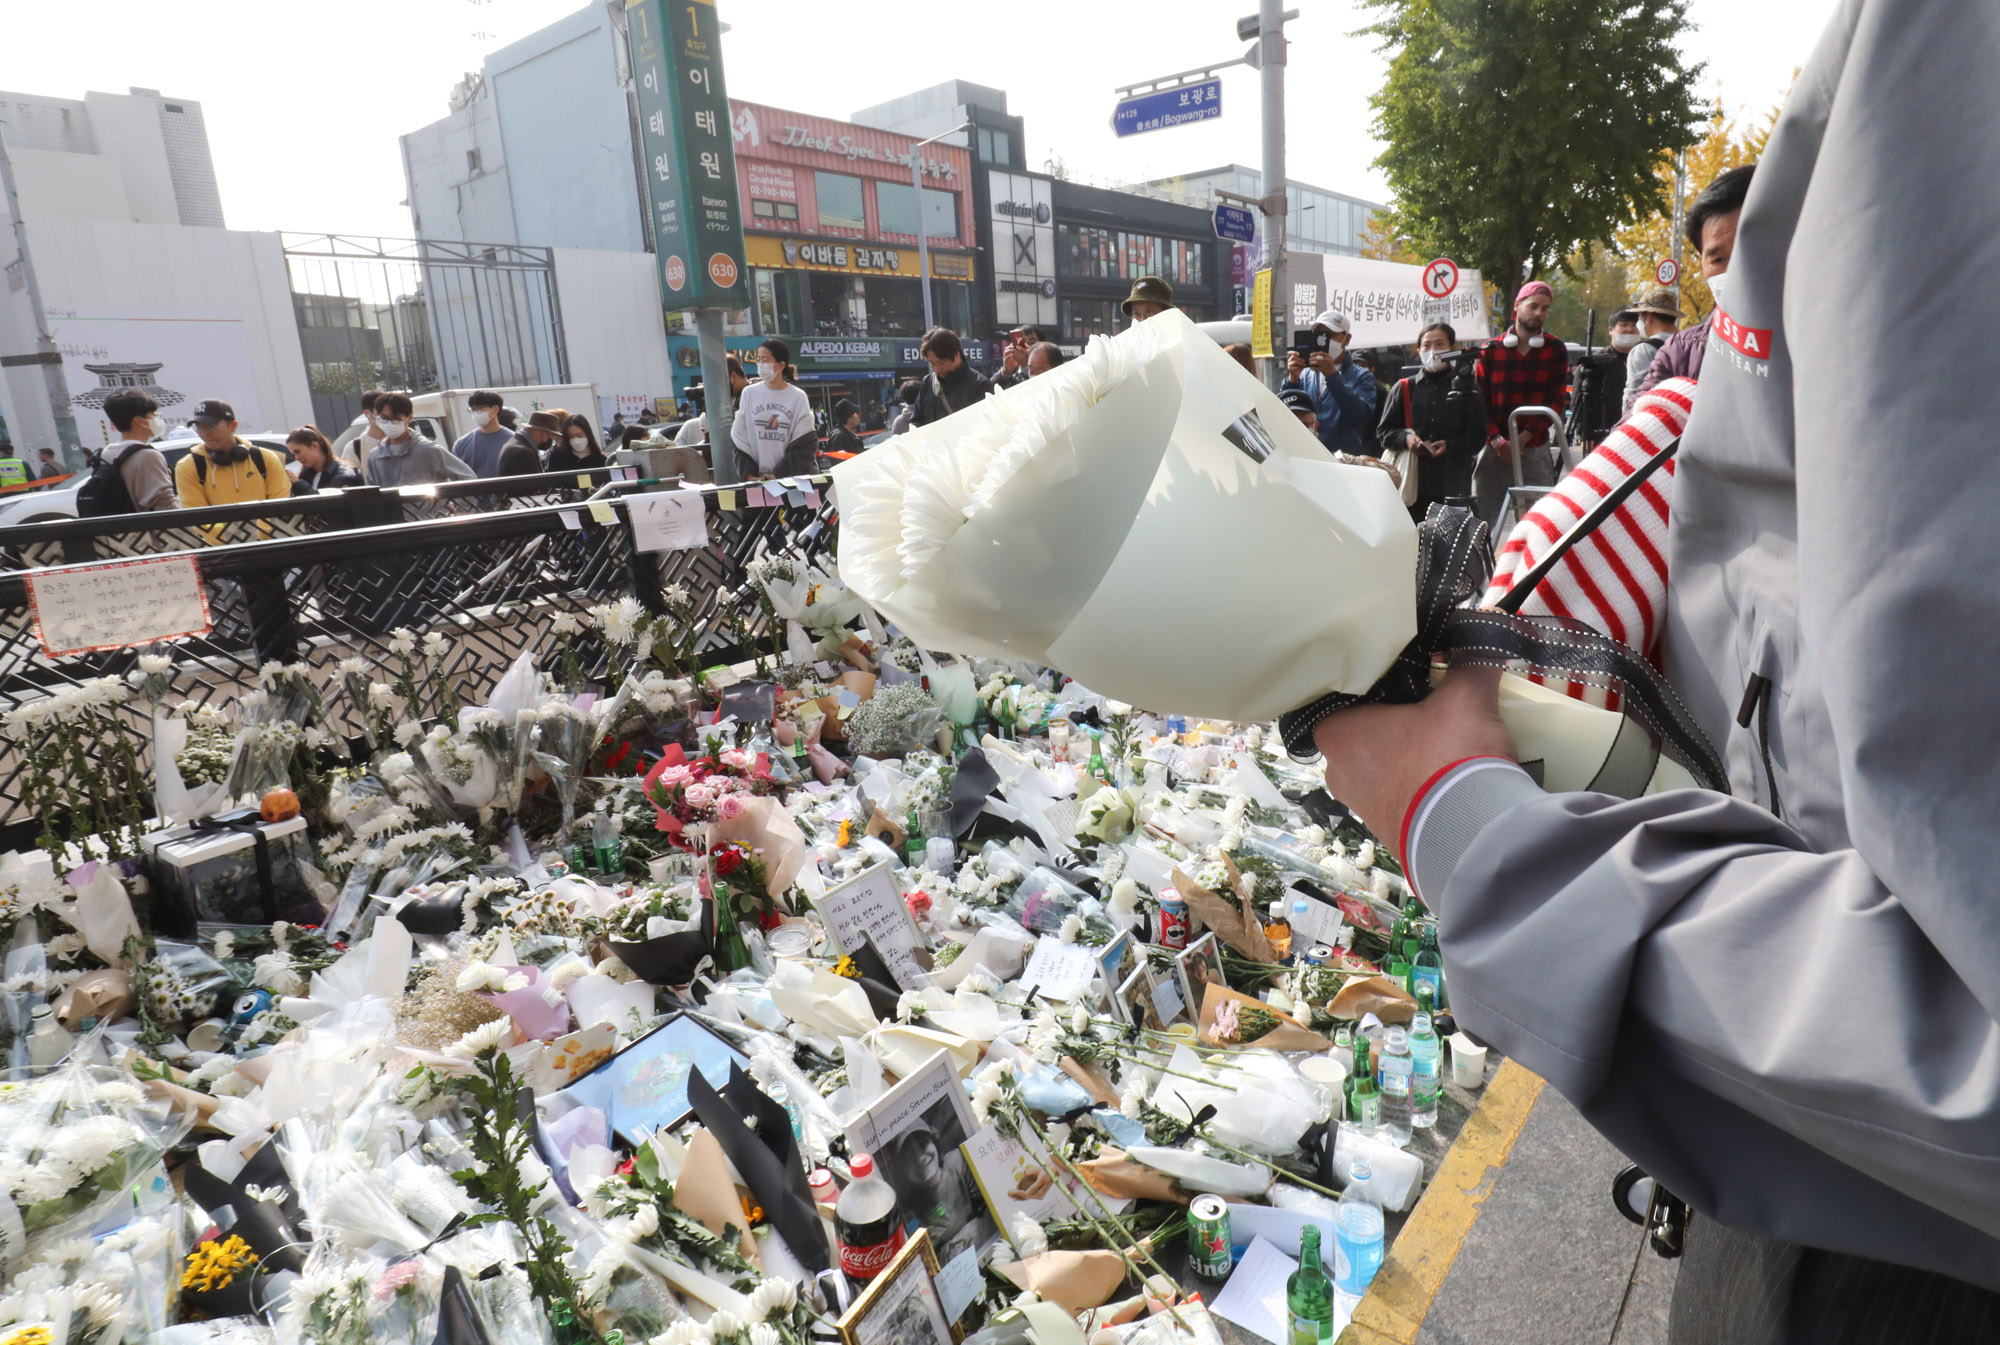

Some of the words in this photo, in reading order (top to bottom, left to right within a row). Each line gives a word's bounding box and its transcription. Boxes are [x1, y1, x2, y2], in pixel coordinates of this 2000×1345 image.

[639, 8, 648, 39] 1
[686, 6, 699, 37] 1
[1178, 86, 1218, 106] 보광로
[643, 66, 671, 182] 이태원
[689, 66, 721, 180] 이태원
[701, 195, 728, 208] Itaewon
[712, 262, 735, 278] 630
[801, 243, 848, 267] 이바돔
[854, 246, 899, 270] 감자탕
[668, 265, 683, 281] 630
[1661, 264, 1673, 280] 50
[800, 342, 844, 354] ALPEDO
[846, 342, 881, 354] KEBAB
[1729, 350, 1769, 378] TEAM
[752, 402, 765, 416] LOS
[889, 1109, 910, 1132] peace
[909, 1090, 933, 1114] Steven
[840, 1238, 894, 1267] Coca-Cola
